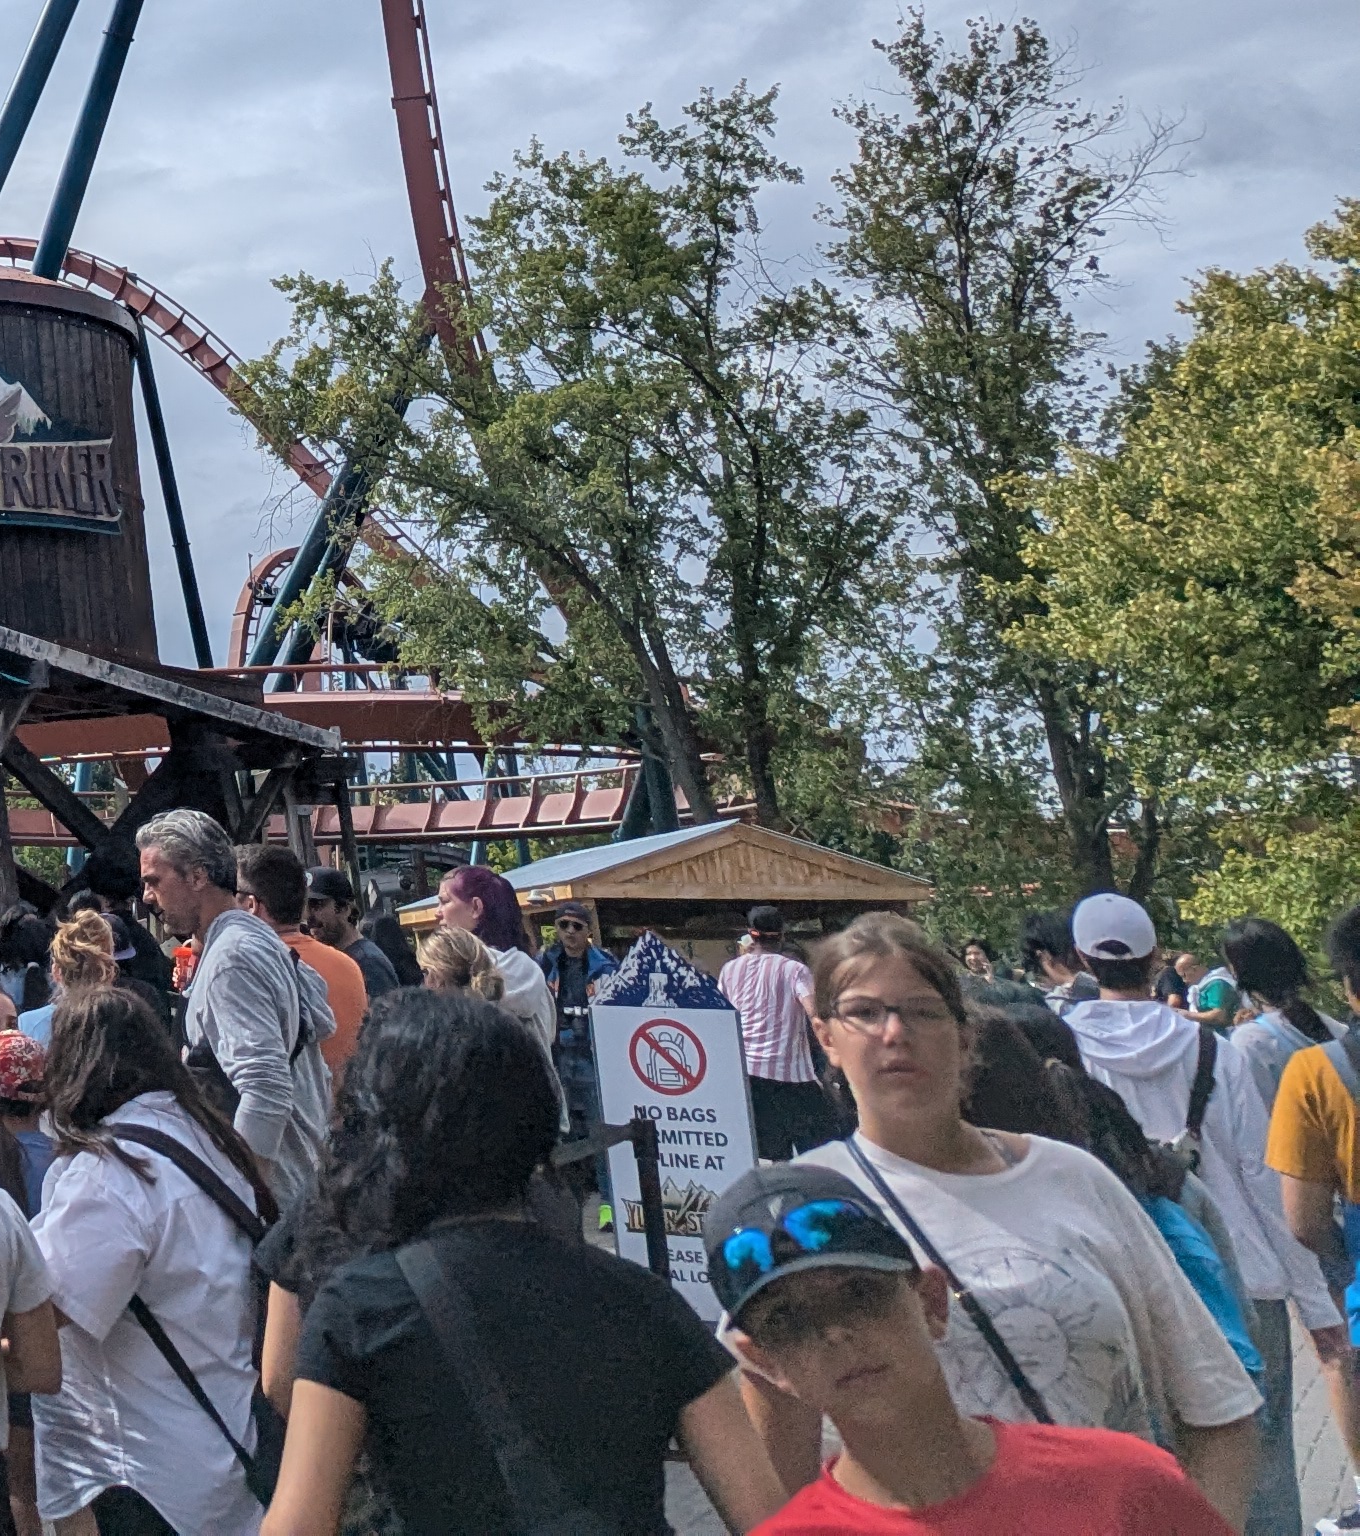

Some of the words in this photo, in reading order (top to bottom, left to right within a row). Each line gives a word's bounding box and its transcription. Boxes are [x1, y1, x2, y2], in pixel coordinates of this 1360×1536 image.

[633, 1104, 662, 1122] NO
[666, 1106, 717, 1123] BAGS
[660, 1152, 700, 1170] LINE
[704, 1155, 726, 1171] AT
[668, 1248, 704, 1263] EASE
